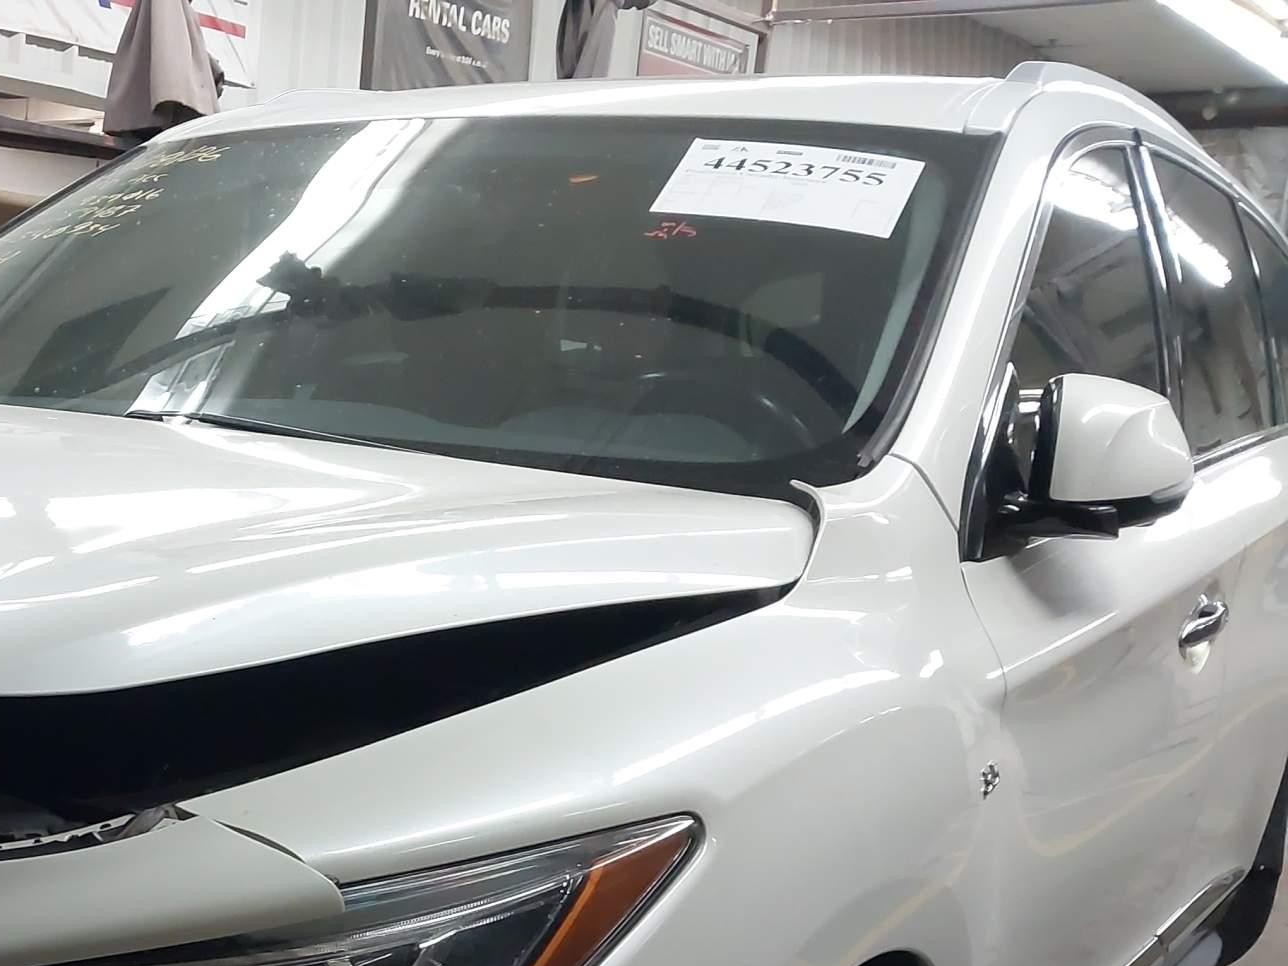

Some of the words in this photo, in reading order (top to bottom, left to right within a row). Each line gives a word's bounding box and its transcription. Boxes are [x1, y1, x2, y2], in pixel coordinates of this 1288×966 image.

[408, 0, 466, 32] RENTAL
[471, 10, 510, 44] CARS
[648, 24, 669, 53] SELL
[670, 32, 703, 63] SMART
[703, 156, 887, 186] 44523755
